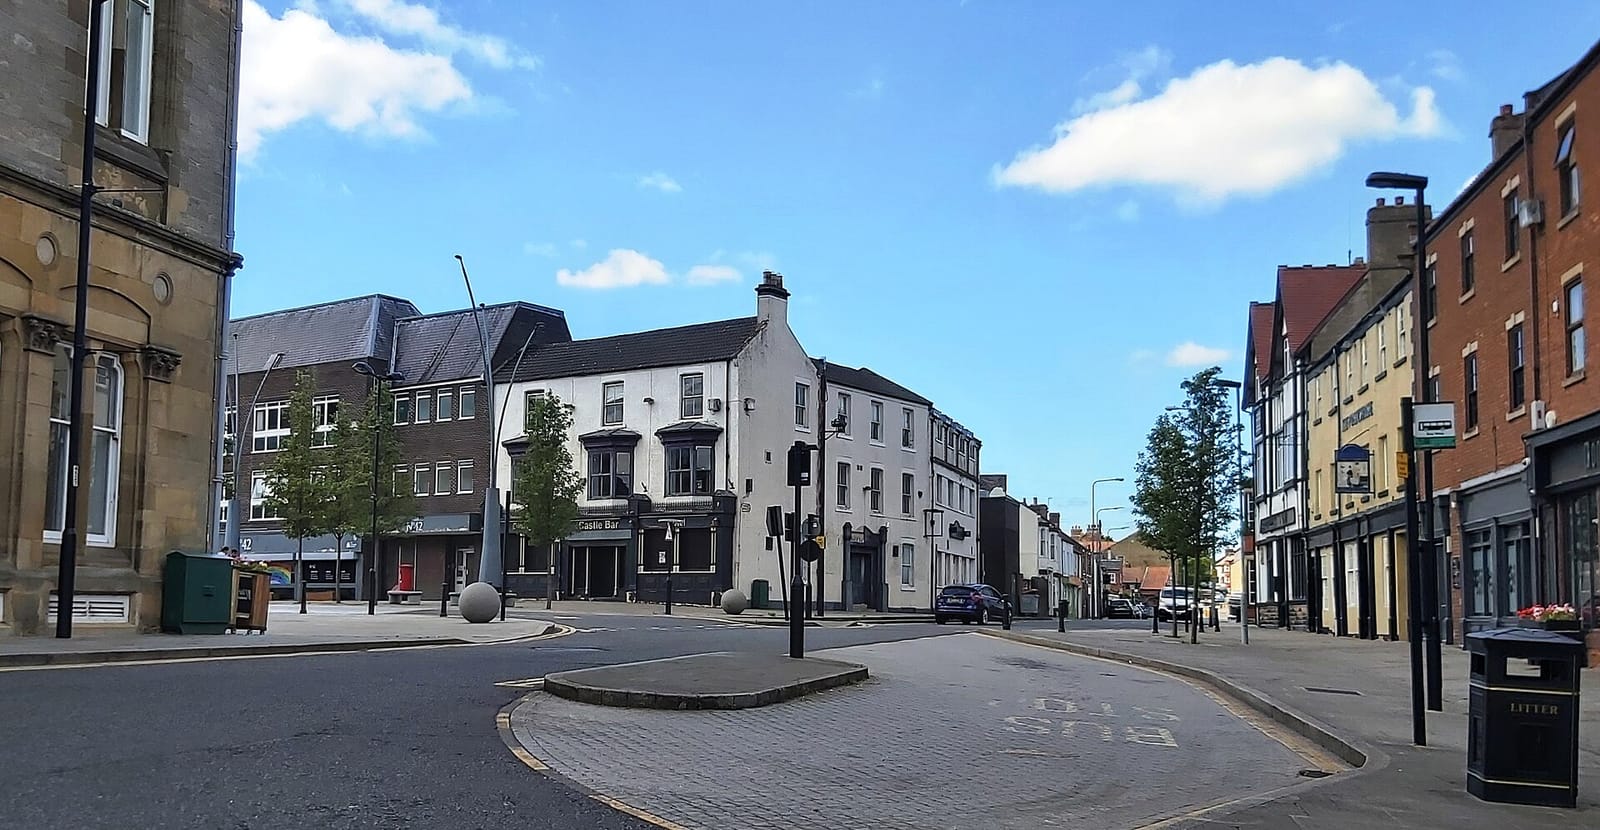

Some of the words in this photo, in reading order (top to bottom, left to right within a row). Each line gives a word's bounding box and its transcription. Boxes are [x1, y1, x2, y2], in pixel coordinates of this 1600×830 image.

[604, 520, 619, 529] Bar
[1510, 703, 1559, 715] LITTER
[1004, 716, 1179, 747] BUS
